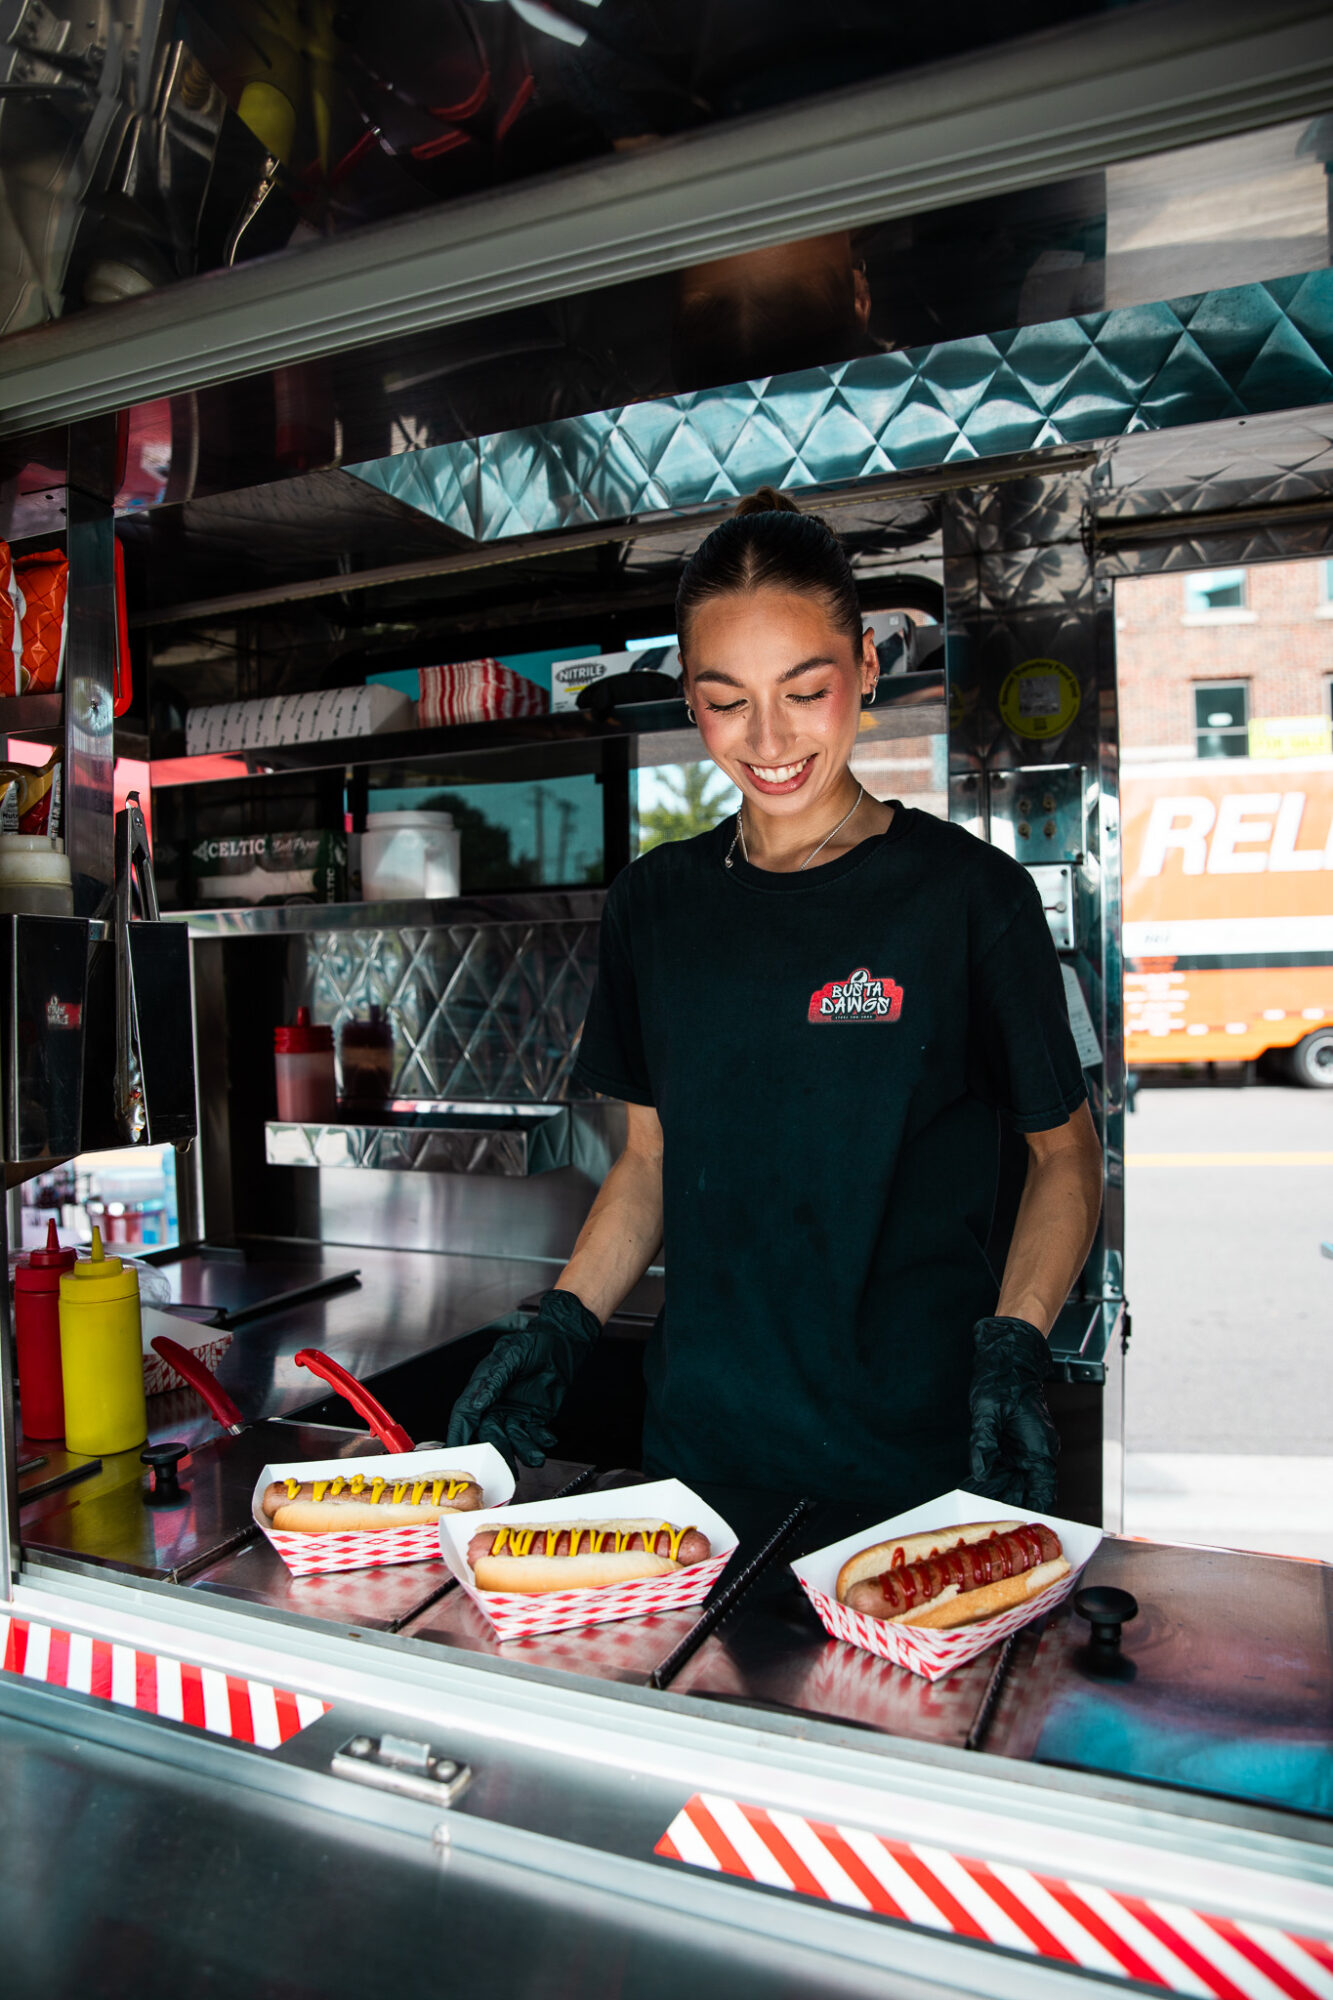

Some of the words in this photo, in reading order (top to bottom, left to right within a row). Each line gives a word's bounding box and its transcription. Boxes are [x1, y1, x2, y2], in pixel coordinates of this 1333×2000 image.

[560, 665, 603, 680] NITRILE
[1138, 791, 1333, 877] REL
[208, 839, 266, 857] CELTIC
[326, 867, 335, 902] ELTIC
[832, 981, 882, 998] BUSTA
[819, 997, 890, 1015] DAWGS
